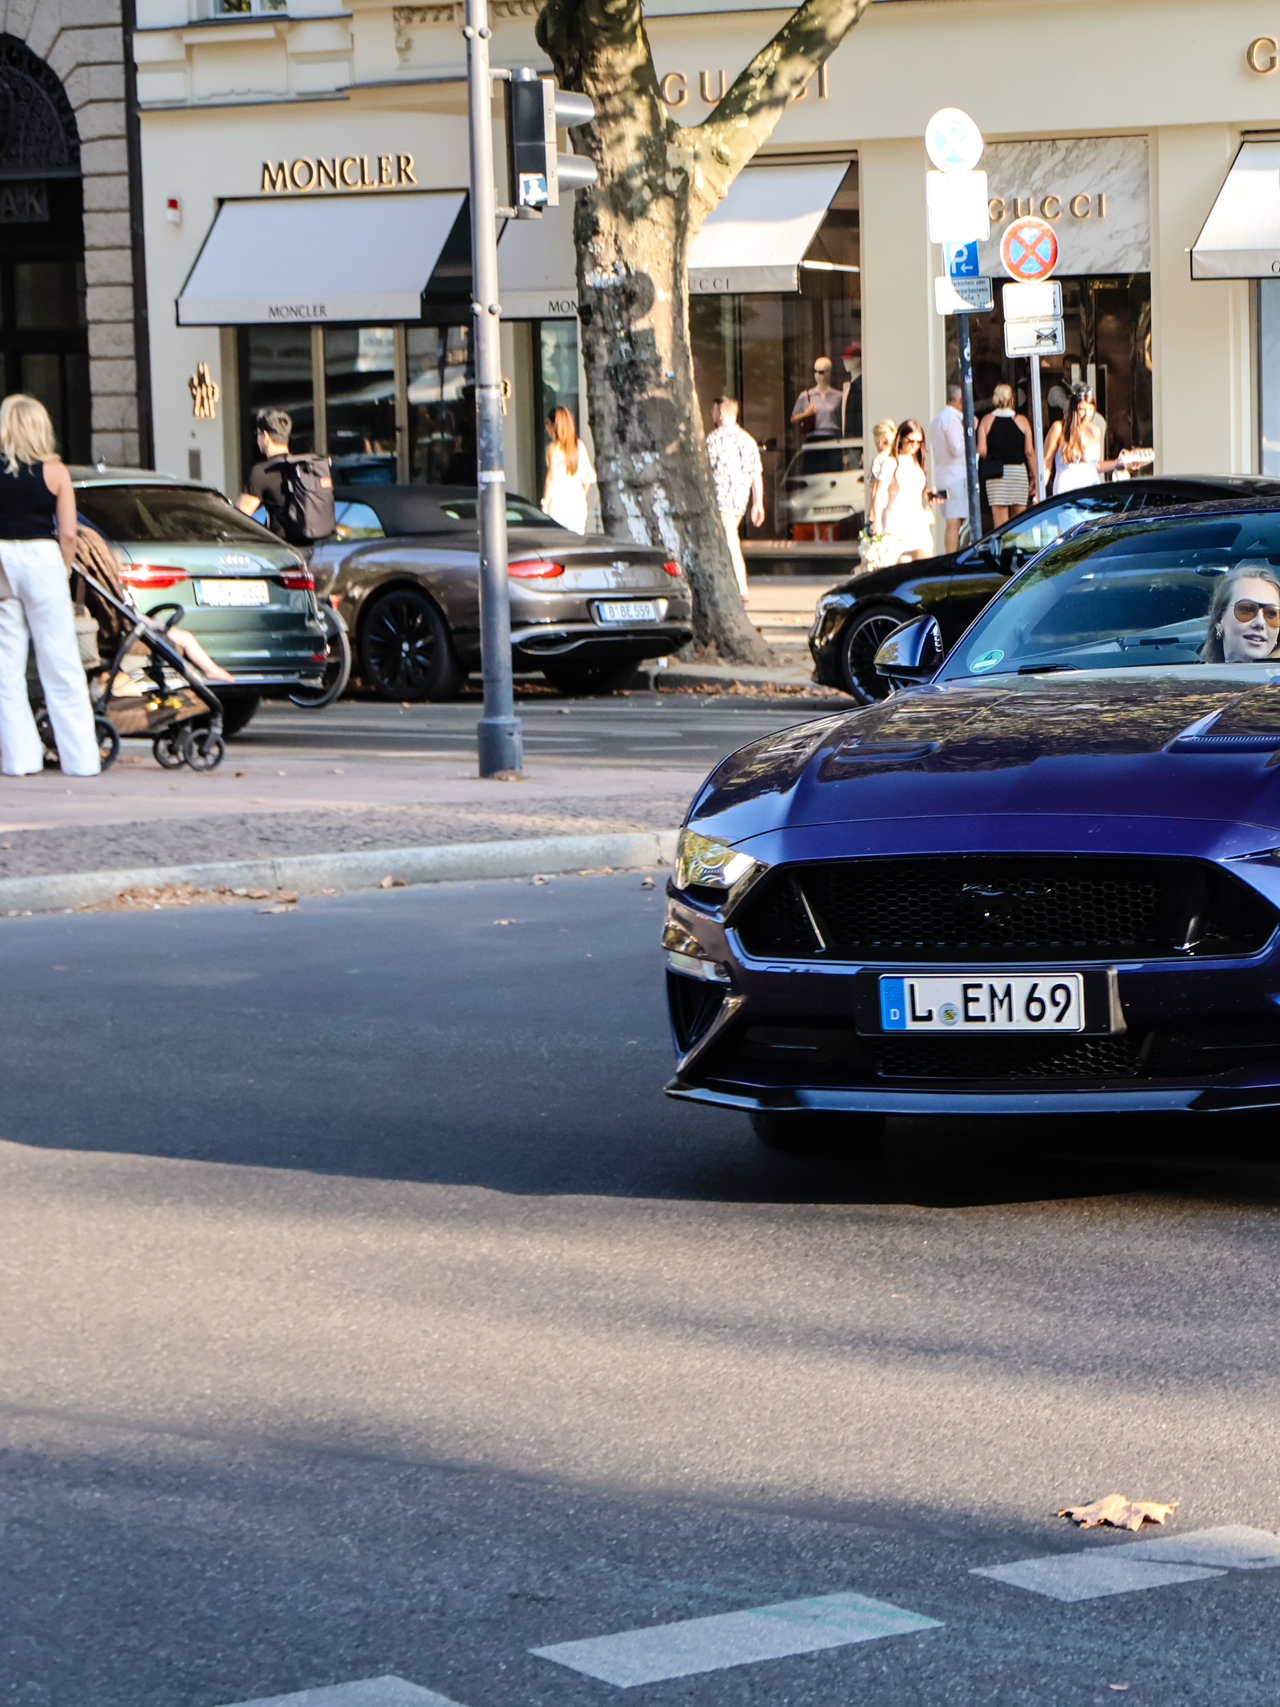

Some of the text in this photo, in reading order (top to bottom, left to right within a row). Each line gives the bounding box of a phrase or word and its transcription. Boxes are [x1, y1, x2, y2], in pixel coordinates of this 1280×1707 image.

[661, 61, 829, 106] GUI
[261, 153, 417, 193] MONCLER
[0, 187, 46, 216] AK
[988, 193, 1106, 222] GUCCI
[688, 279, 730, 291] UCCI
[268, 304, 327, 319] MONCLER
[608, 605, 615, 618] B
[634, 604, 650, 618] 559
[891, 983, 1072, 1023] D L EM 69
